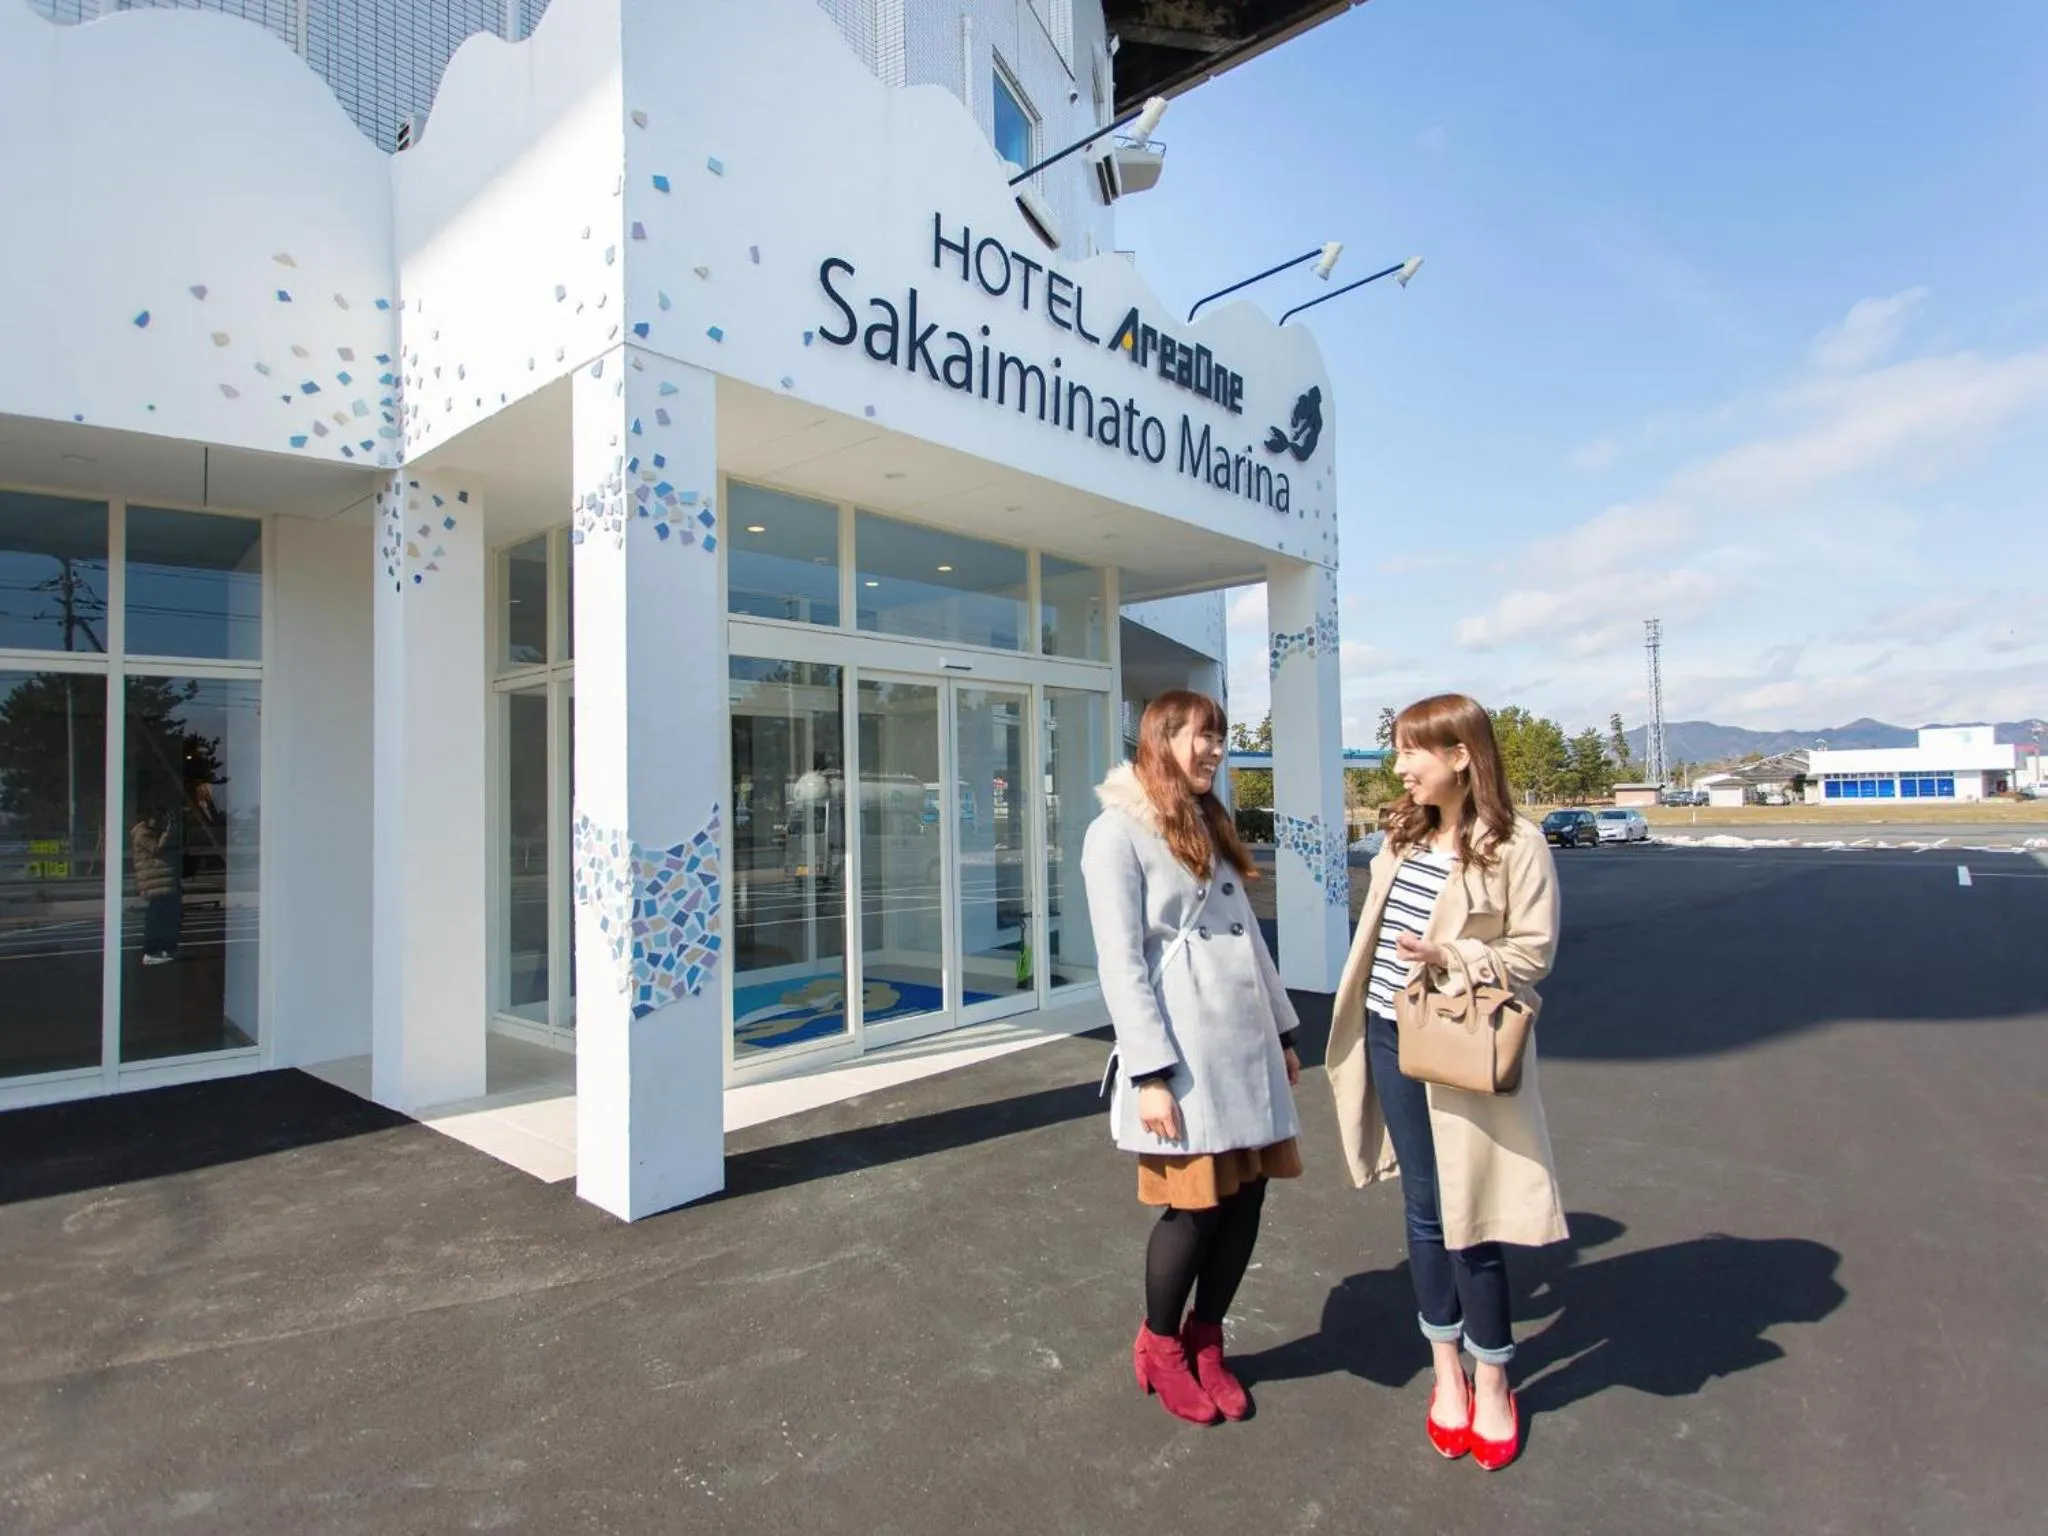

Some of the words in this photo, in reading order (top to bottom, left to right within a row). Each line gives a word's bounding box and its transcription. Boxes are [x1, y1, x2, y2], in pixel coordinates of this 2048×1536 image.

[818, 256, 1167, 465] Sakaiminato
[1178, 414, 1291, 515] Marina
[933, 211, 1100, 344] HOTEL
[1108, 307, 1244, 415] AreaOne
